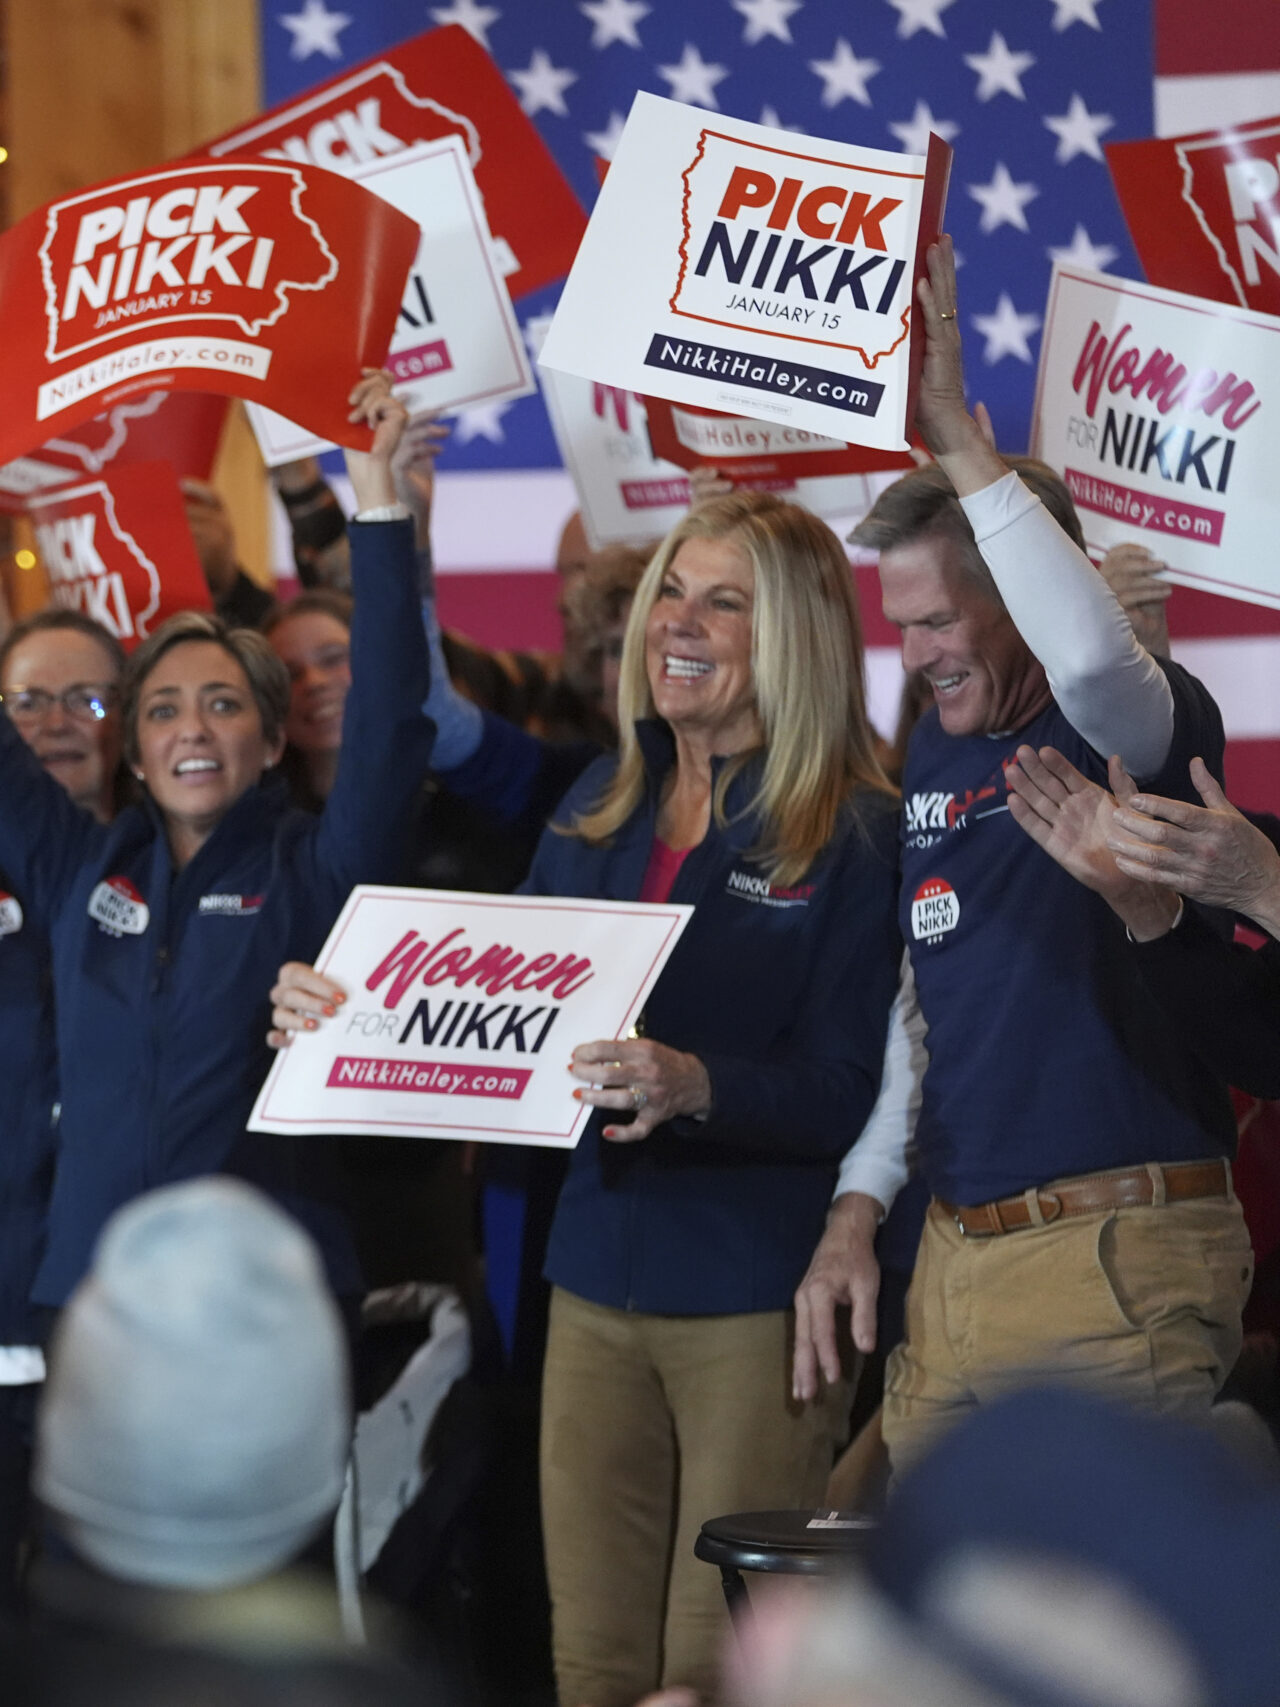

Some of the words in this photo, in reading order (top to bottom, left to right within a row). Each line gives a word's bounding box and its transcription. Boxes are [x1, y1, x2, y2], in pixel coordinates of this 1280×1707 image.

[260, 97, 407, 170] ICK
[73, 185, 260, 266] PICK
[717, 166, 904, 252] PICK
[62, 234, 275, 322] NIKKI
[694, 221, 907, 315] NIKKI
[94, 292, 183, 330] JANUARY
[190, 290, 214, 306] 15
[726, 294, 815, 325] JANUARY
[821, 312, 842, 330] 15
[49, 346, 256, 405] NikkiHaley.com
[659, 340, 870, 407] NikkiHaley.com
[1072, 319, 1262, 432] Women
[1068, 415, 1099, 450] FOR
[1099, 406, 1236, 495] NIKKI
[1070, 473, 1213, 538] NikkiHaley.com
[37, 513, 107, 582] ICK
[918, 912, 954, 934] NIKKI
[925, 896, 953, 916] PICK
[365, 928, 596, 1010] Women
[345, 1010, 400, 1039] FOR
[397, 998, 561, 1054] NIKKI
[337, 1059, 519, 1095] NikkiHaley.com
